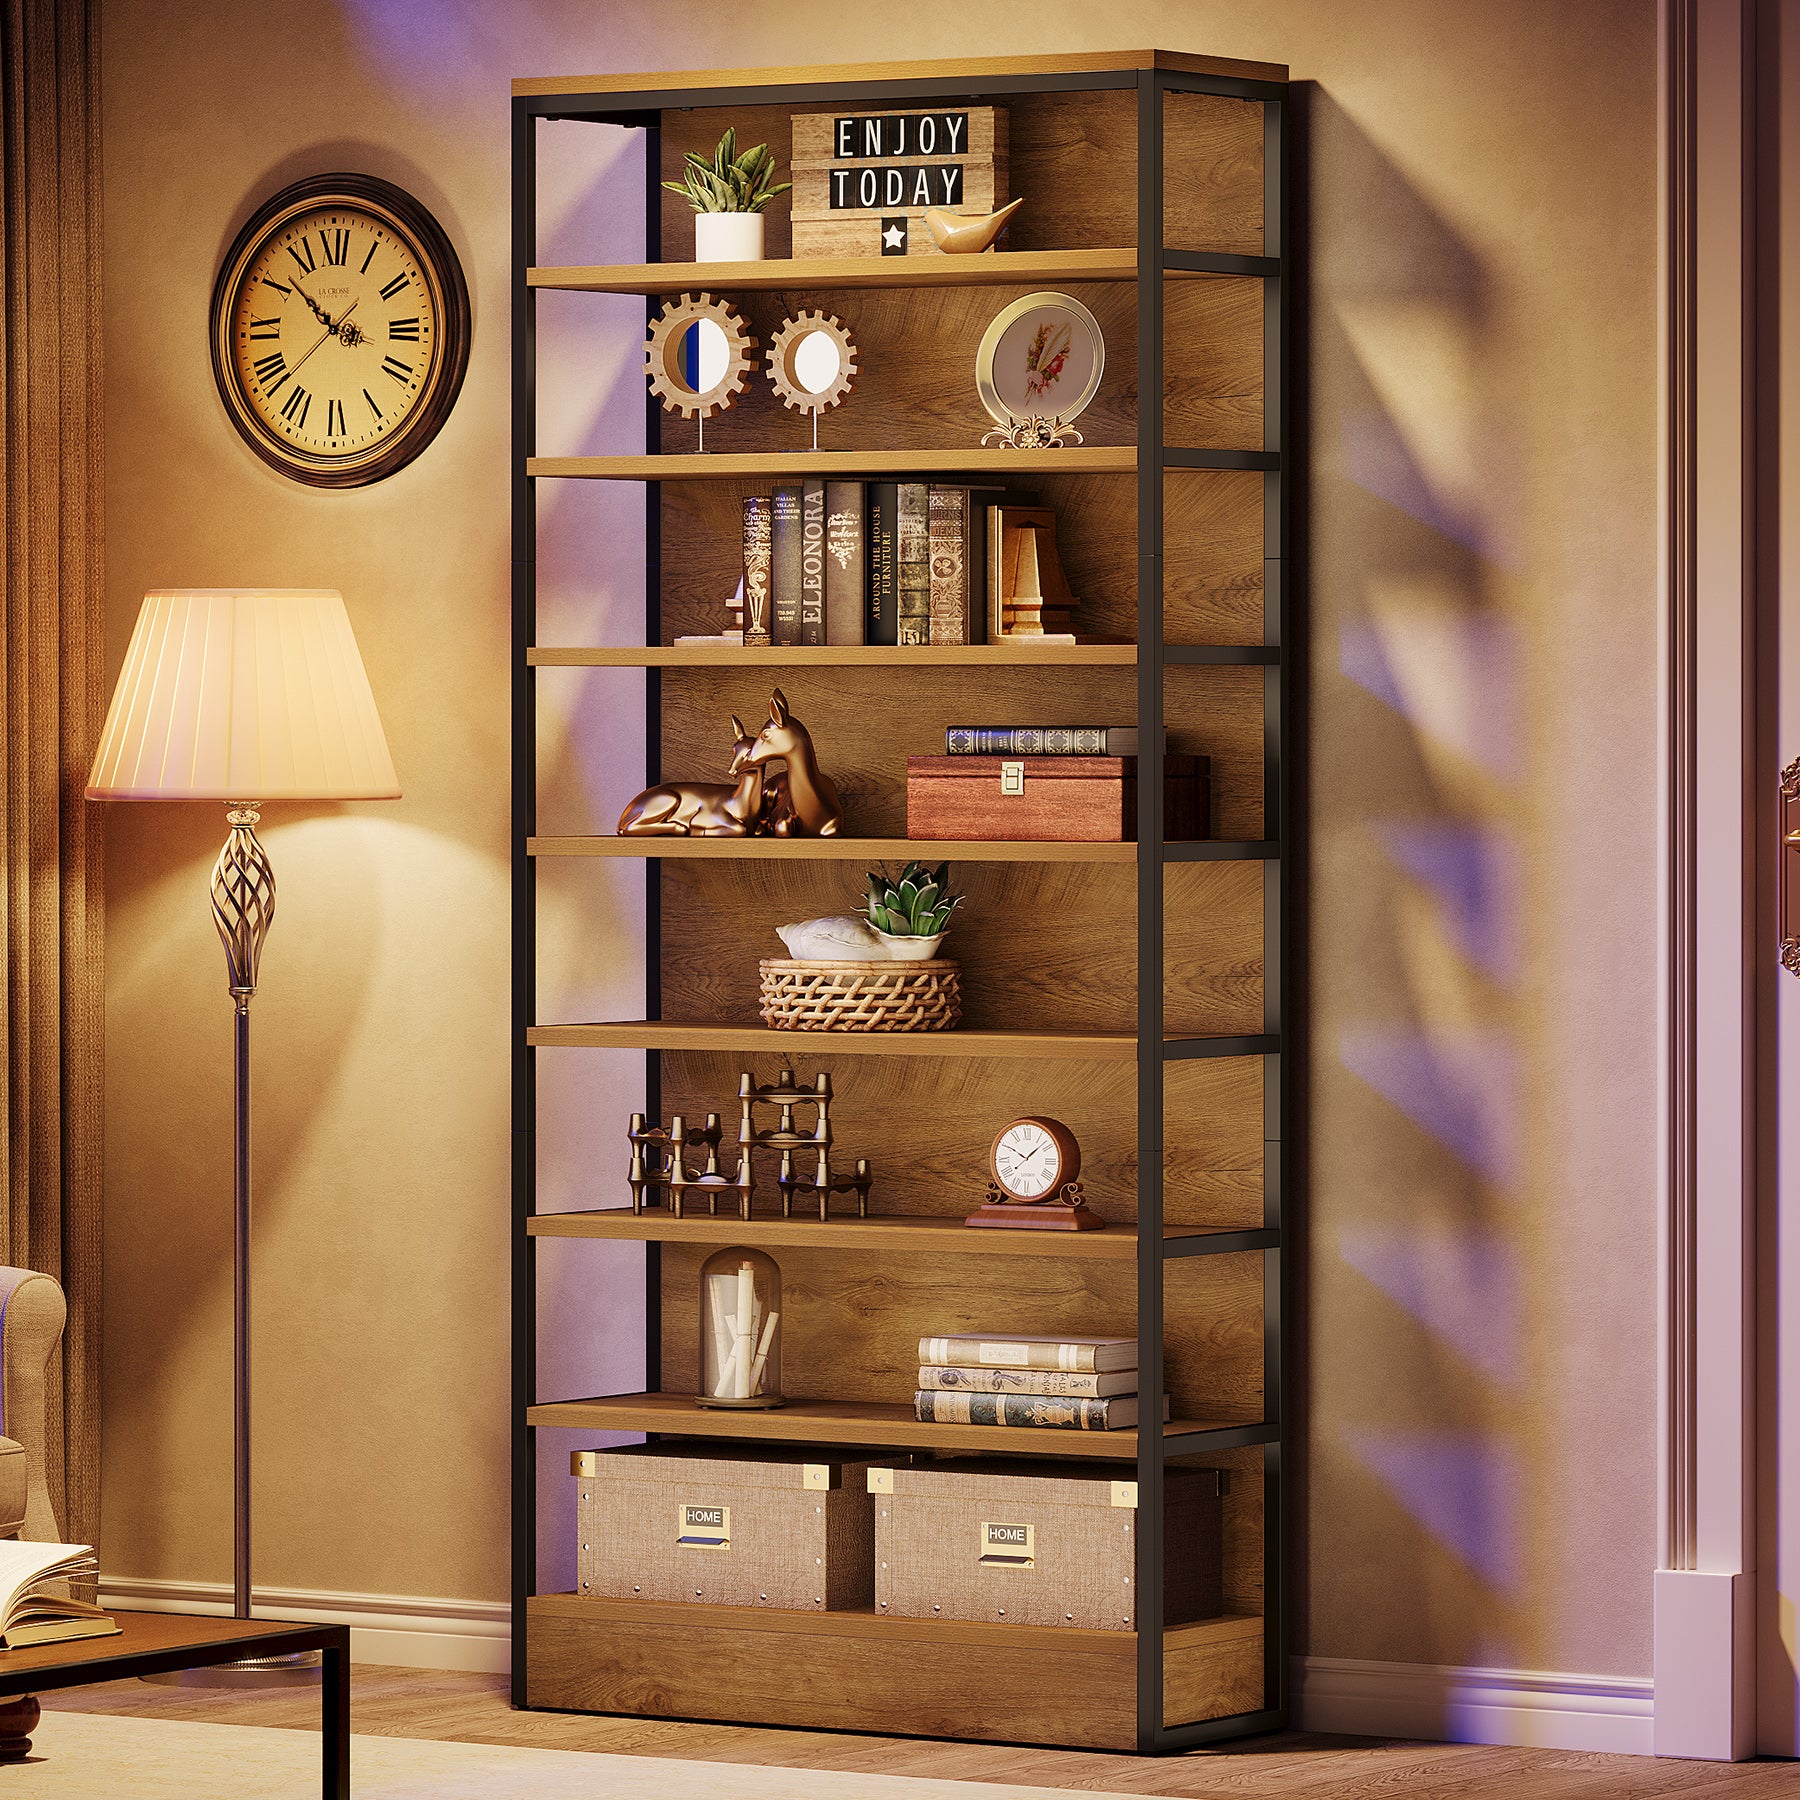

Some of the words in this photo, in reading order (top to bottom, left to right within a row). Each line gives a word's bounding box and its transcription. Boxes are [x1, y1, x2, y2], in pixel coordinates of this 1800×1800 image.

[838, 116, 963, 157] ENJOY
[833, 168, 959, 207] TODAY
[286, 235, 317, 280] XI
[318, 228, 351, 267] XII
[261, 269, 292, 303] X
[378, 270, 411, 302] II
[388, 316, 420, 343] III
[253, 351, 291, 400] VIII
[280, 384, 312, 429] VII
[327, 399, 347, 437] VI
[873, 505, 881, 543] HOUSE
[803, 490, 824, 624] ELEONORA
[873, 546, 881, 569] THE
[882, 531, 891, 595] FURNITURE
[873, 573, 881, 620] AROUND
[686, 1510, 721, 1523] HOME
[989, 1528, 1025, 1541] HOME
